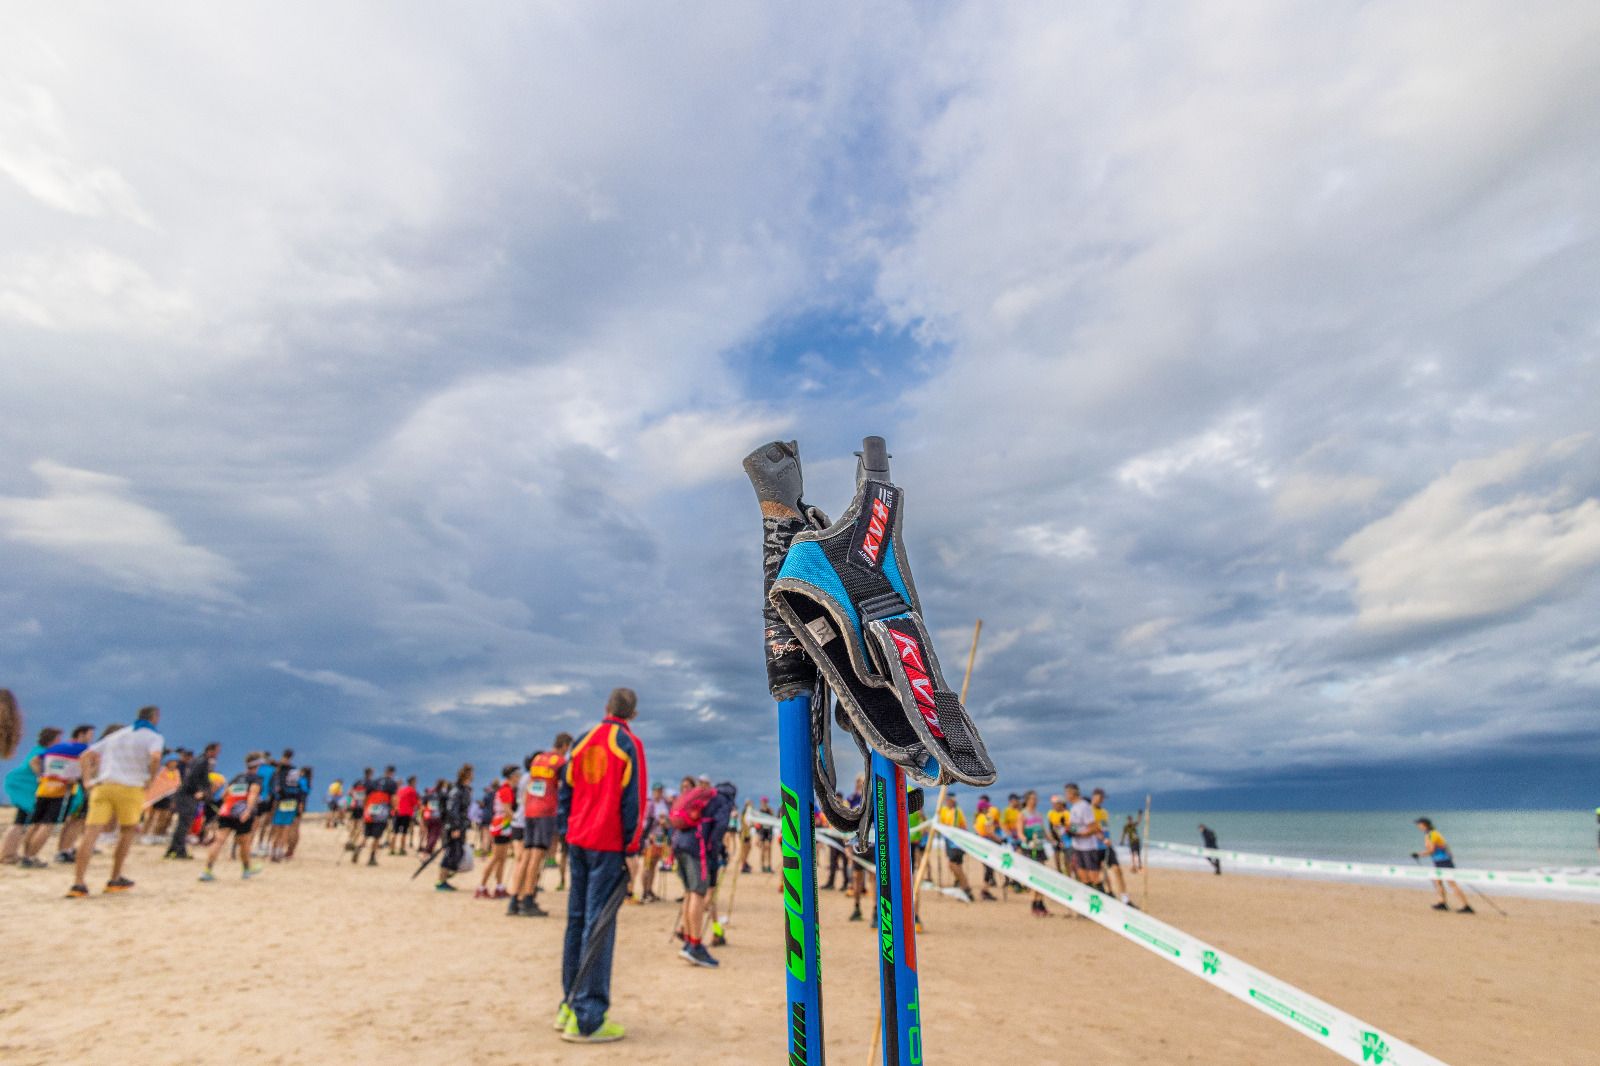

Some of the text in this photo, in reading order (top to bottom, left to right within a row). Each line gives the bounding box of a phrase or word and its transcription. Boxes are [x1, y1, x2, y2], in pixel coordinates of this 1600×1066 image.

[885, 490, 893, 508] ELITE
[862, 502, 888, 562] KV+
[877, 782, 886, 833] SWITZERLAND
[879, 844, 888, 886] DESIGNED
[880, 896, 894, 964] KV+
